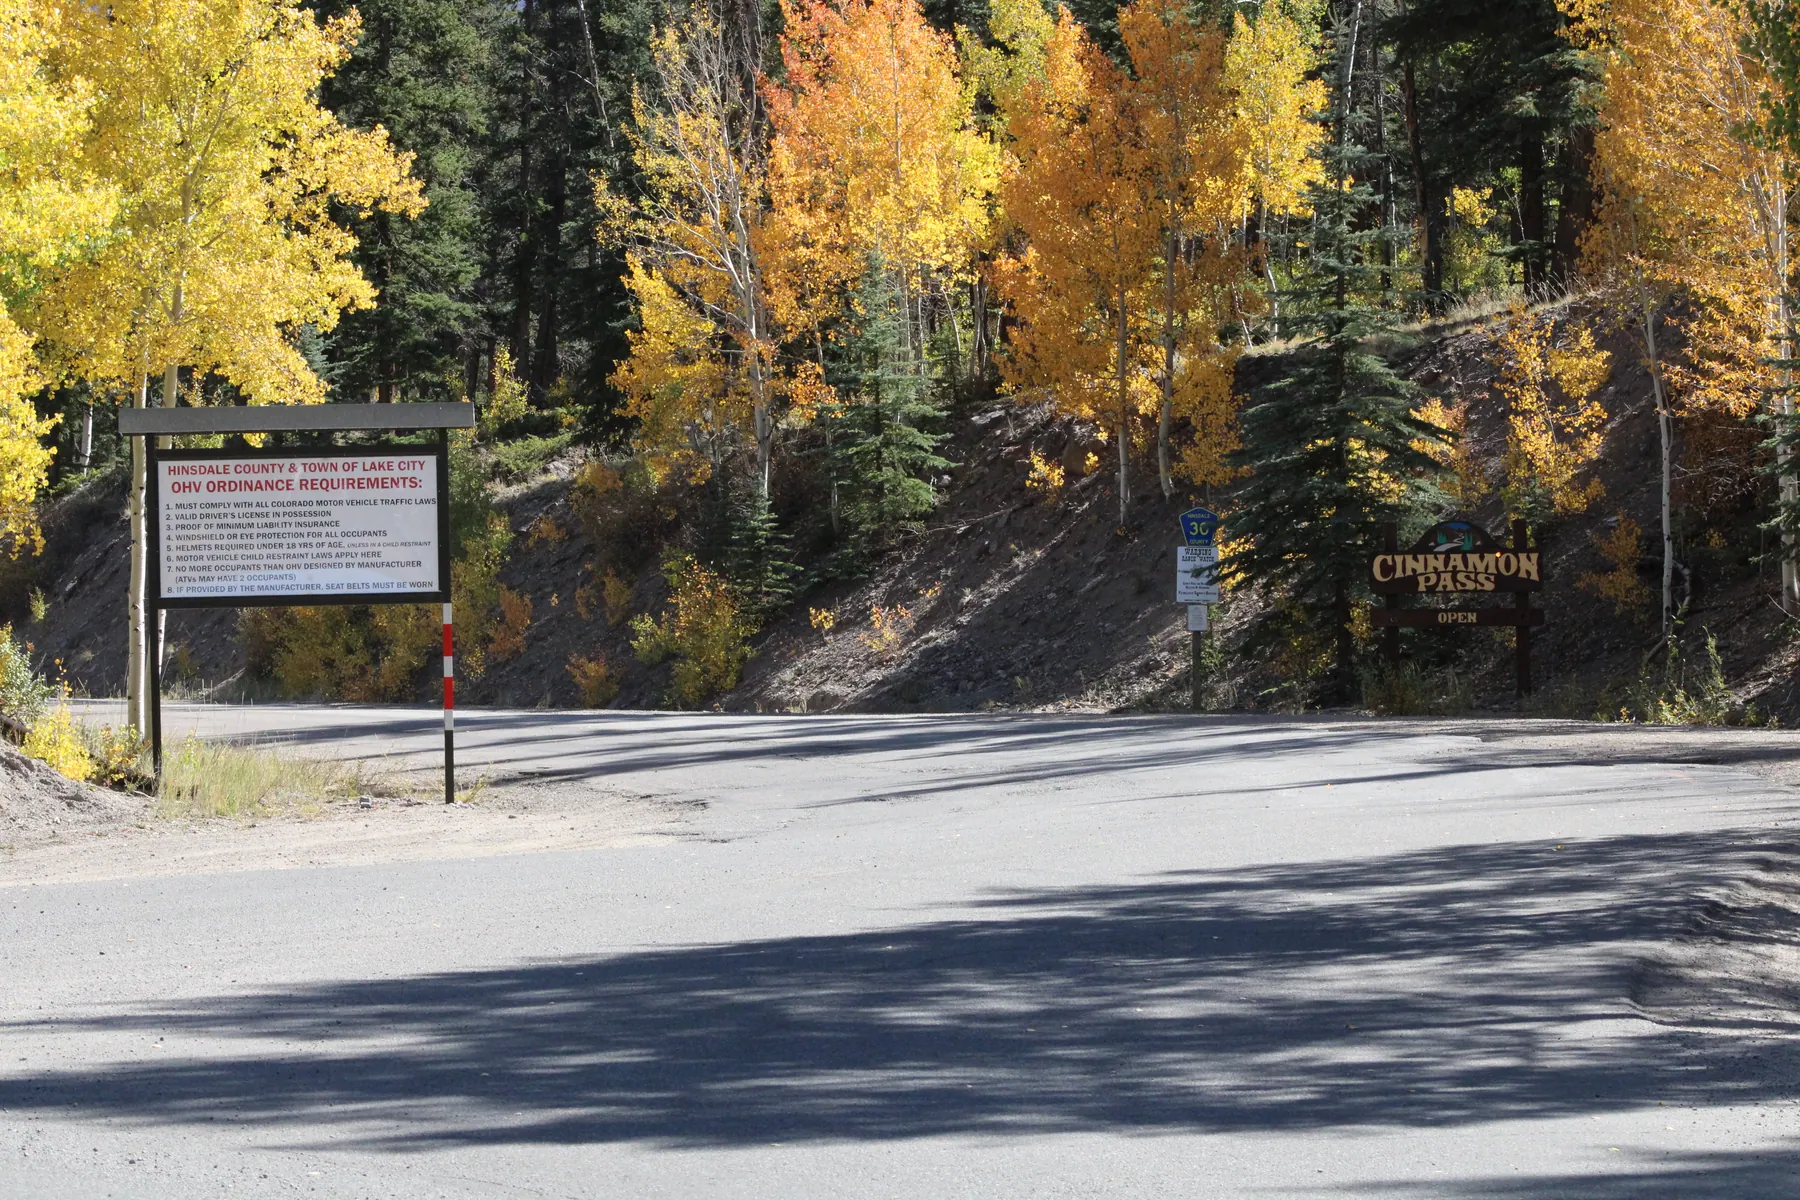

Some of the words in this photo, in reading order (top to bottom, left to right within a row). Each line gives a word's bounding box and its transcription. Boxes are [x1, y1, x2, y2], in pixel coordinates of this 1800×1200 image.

[168, 464, 230, 475] HINSDALE
[234, 463, 284, 474] COUNTY
[288, 463, 297, 473] &
[301, 462, 338, 472] TOWN
[342, 462, 358, 472] OF
[362, 462, 394, 471] LAKE
[398, 460, 426, 471] CITY
[171, 481, 202, 493] OHV
[206, 479, 294, 493] ORDINANCE
[300, 477, 422, 492] REQUIREMENTS:
[341, 530, 387, 538] OCCUPANTS
[1190, 522, 1209, 535] 30
[1372, 553, 1539, 582] CINNAMON
[1417, 572, 1495, 592] PASS
[1438, 612, 1477, 623] OPEN
